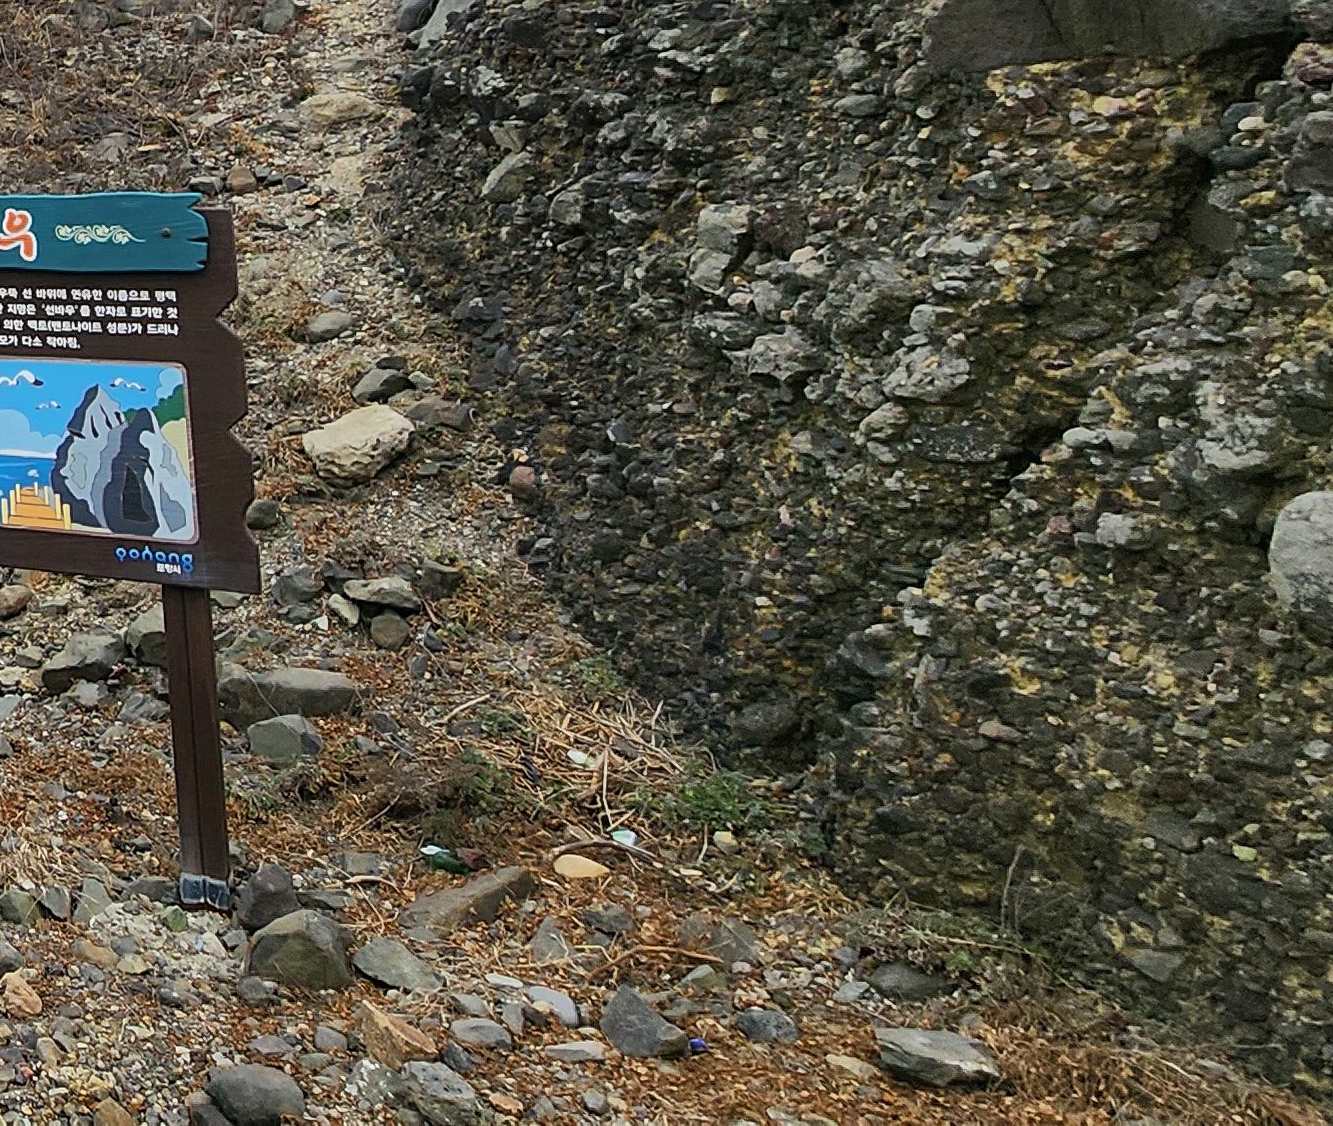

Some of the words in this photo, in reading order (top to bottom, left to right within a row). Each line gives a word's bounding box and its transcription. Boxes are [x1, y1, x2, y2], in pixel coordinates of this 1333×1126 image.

[22, 287, 33, 299] 선
[35, 288, 67, 300] 바위에
[71, 289, 103, 301] 연유한
[107, 289, 151, 302] 이름으로
[155, 290, 177, 302] 평택
[7, 302, 37, 316] 지명은
[94, 305, 128, 317] 한자로
[130, 306, 164, 319] 표기한
[166, 306, 179, 319] 것
[3, 319, 24, 331] 의한
[106, 321, 143, 334] 성분)가
[146, 323, 179, 336] 드러나
[21, 335, 43, 347] 다소
[46, 336, 81, 349] 작아짐.
[156, 562, 181, 575] 포항시
